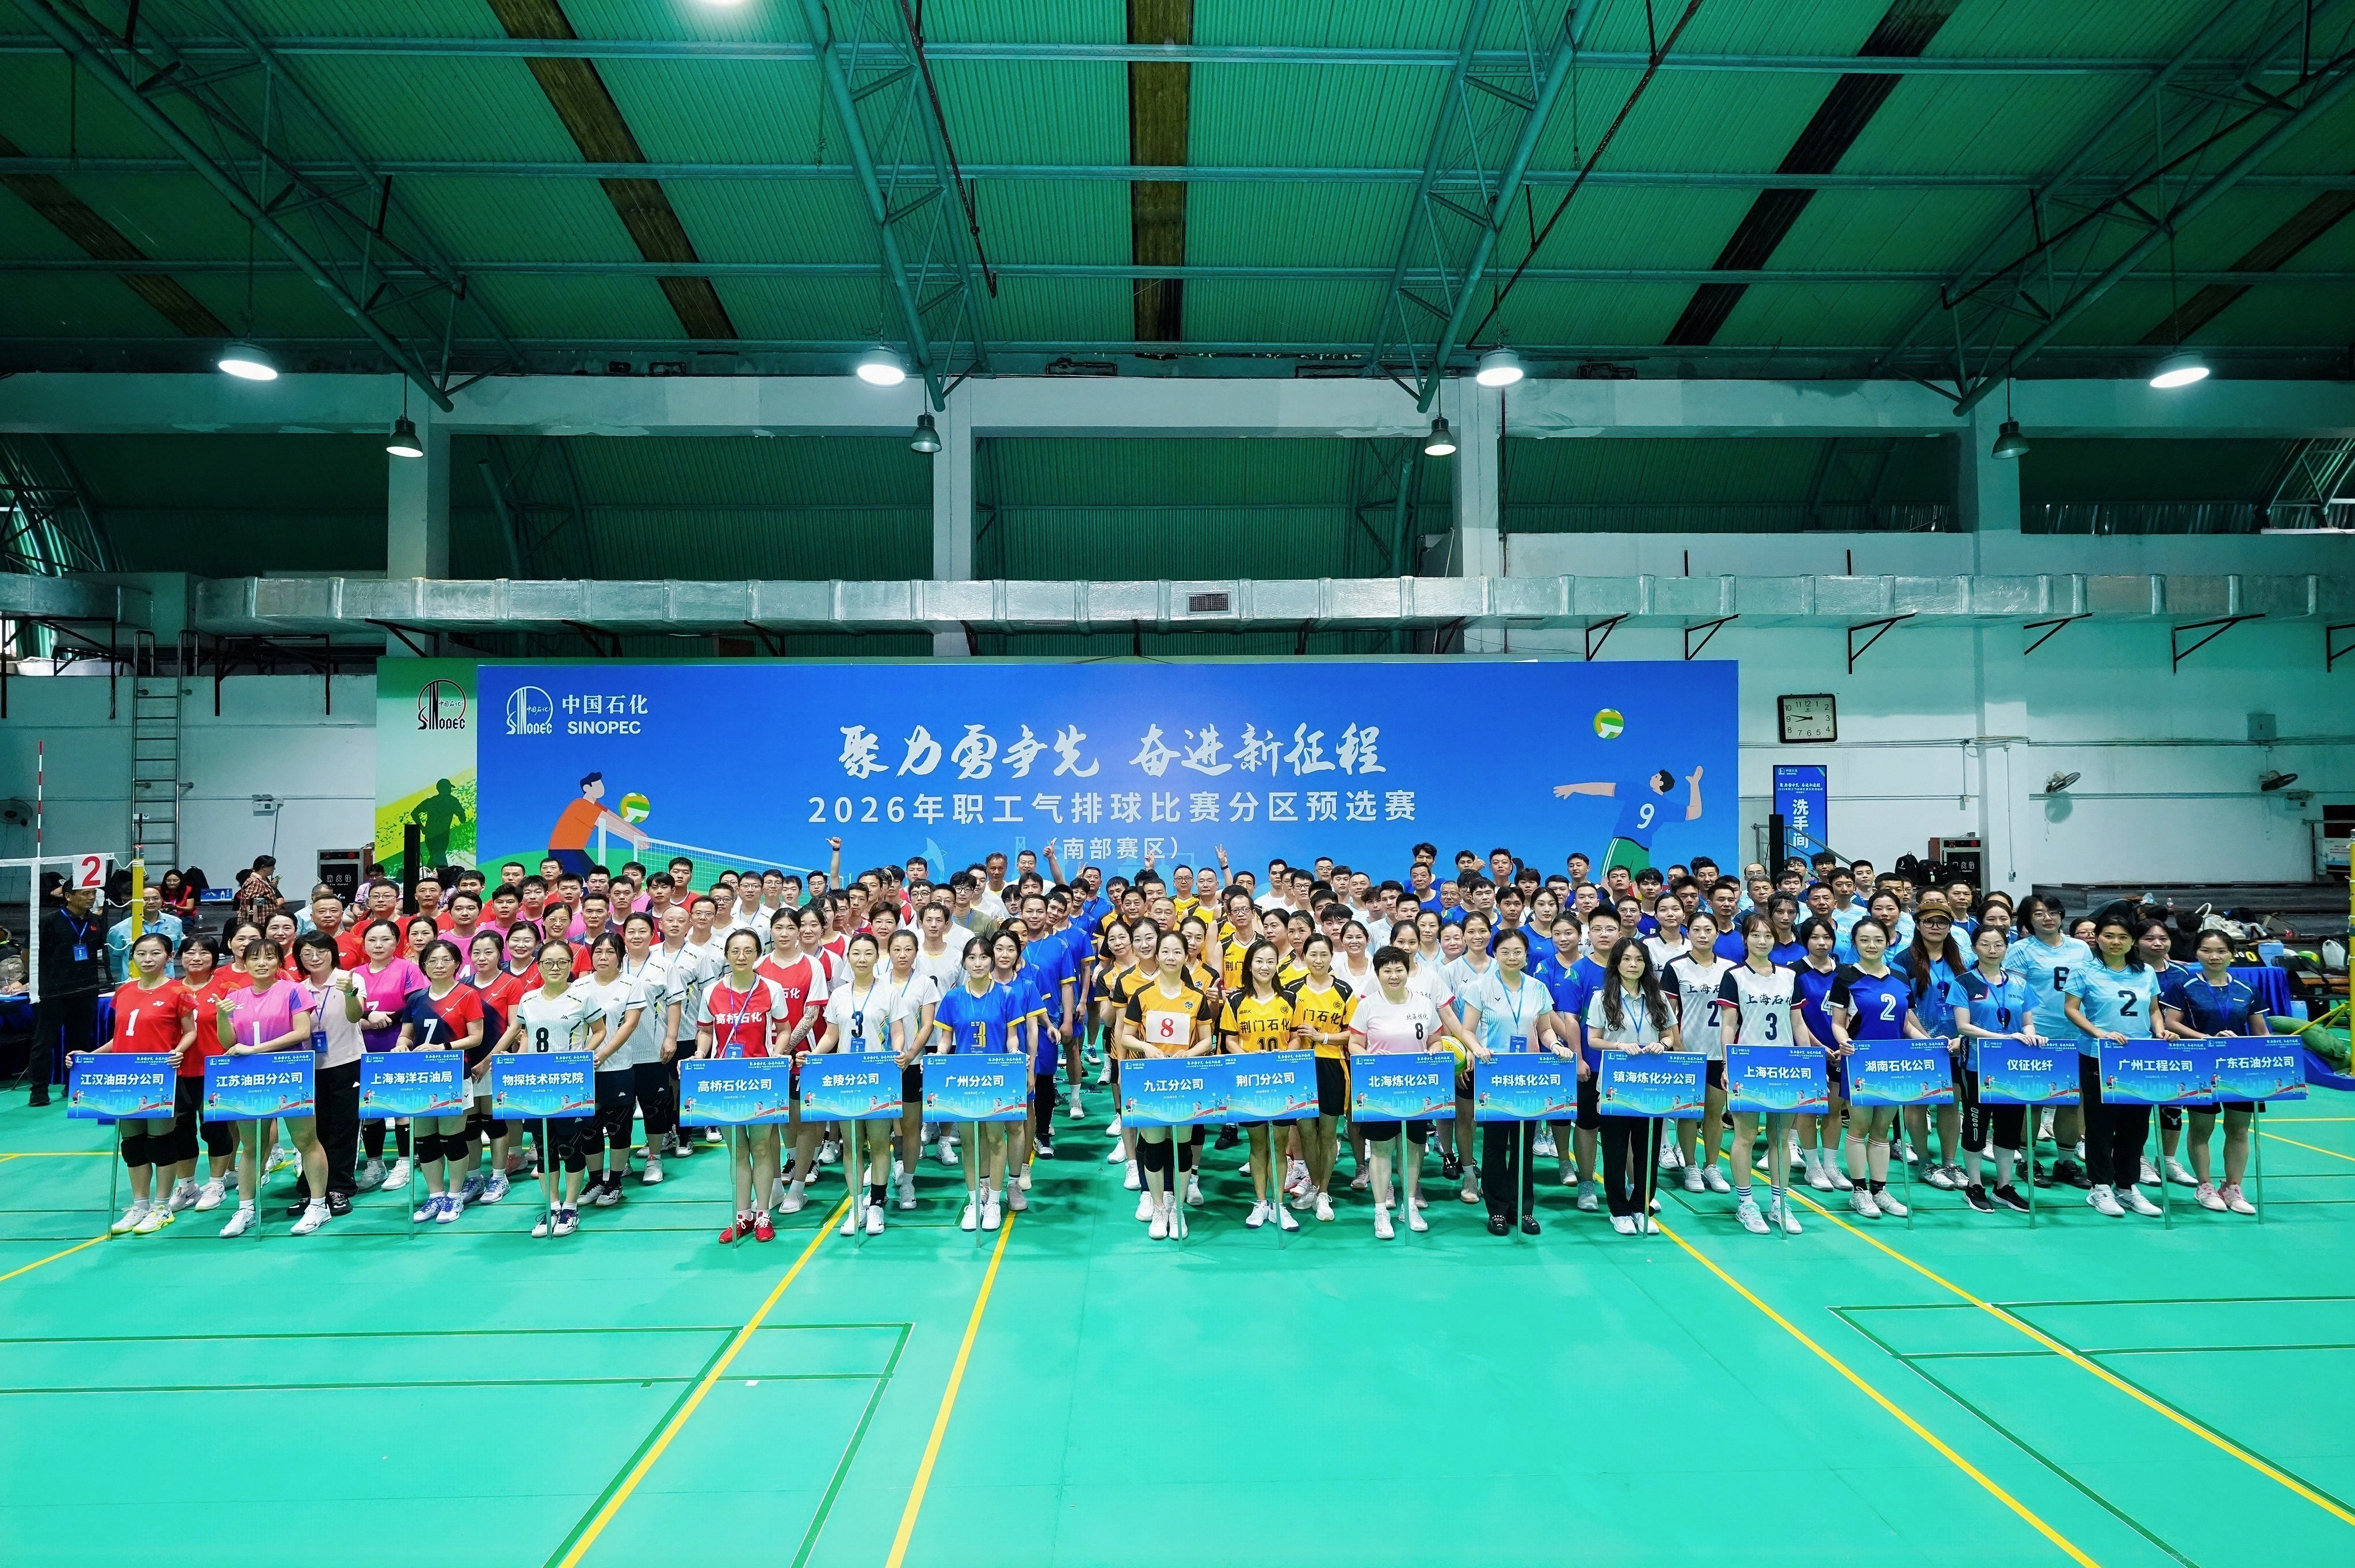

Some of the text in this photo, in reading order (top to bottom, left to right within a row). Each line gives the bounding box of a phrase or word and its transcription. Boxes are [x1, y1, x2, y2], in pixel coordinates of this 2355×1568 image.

[439, 699, 463, 709] 中国石化
[526, 705, 551, 715] 中国石化
[562, 694, 649, 715] 中国石化
[567, 721, 641, 735] SINOPEC
[839, 721, 1387, 779] 聚力勇争先 奋进新征程
[808, 789, 1416, 825] 2026年职工气排球比赛分区预选赛
[1636, 803, 1654, 829] 9
[1792, 798, 1808, 848] 洗手间
[82, 856, 100, 886] 2
[1225, 961, 1243, 972] 荆门
[783, 988, 800, 999] 石化
[1686, 984, 1720, 993] 上海石
[1880, 993, 1896, 1021] 2
[2117, 990, 2138, 1016] 2
[1304, 1008, 1340, 1025] 门石化
[1707, 1001, 1720, 1027] 2
[125, 1008, 140, 1036] 1
[851, 1011, 863, 1038] 3
[1161, 1018, 1173, 1037] 8
[1239, 1018, 1290, 1033] 荆门石化
[1765, 1013, 1777, 1040] 3
[253, 1021, 261, 1046] 1
[423, 1019, 437, 1043] 7
[1415, 1023, 1423, 1040] 8
[536, 1027, 548, 1053] 8
[1257, 1037, 1278, 1050] 10
[1865, 1060, 1934, 1072] 湖南石化公司
[2007, 1060, 2053, 1071] 仪征化纤
[2119, 1060, 2192, 1072] 广州工程公司
[2216, 1057, 2293, 1069] 广东石油分公司
[81, 1074, 163, 1085] 江汉油田分公司
[216, 1072, 302, 1088] 江苏油田分公司
[371, 1071, 452, 1084] 上海海洋石油局
[502, 1072, 583, 1087] 物探技术研究院
[822, 1073, 879, 1086] 金陵分公司
[1236, 1072, 1294, 1087] 荆门分公司
[1613, 1071, 1695, 1085] 镇海炼化分公司
[1744, 1066, 1811, 1079] 上海石化公司
[698, 1079, 771, 1092] 高桥石化公司
[945, 1076, 1003, 1087] 广州分公司
[1144, 1079, 1203, 1092] 九江分公司
[1369, 1074, 1438, 1087] 北海炼化公司
[1492, 1074, 1560, 1087] 中科炼化公司
